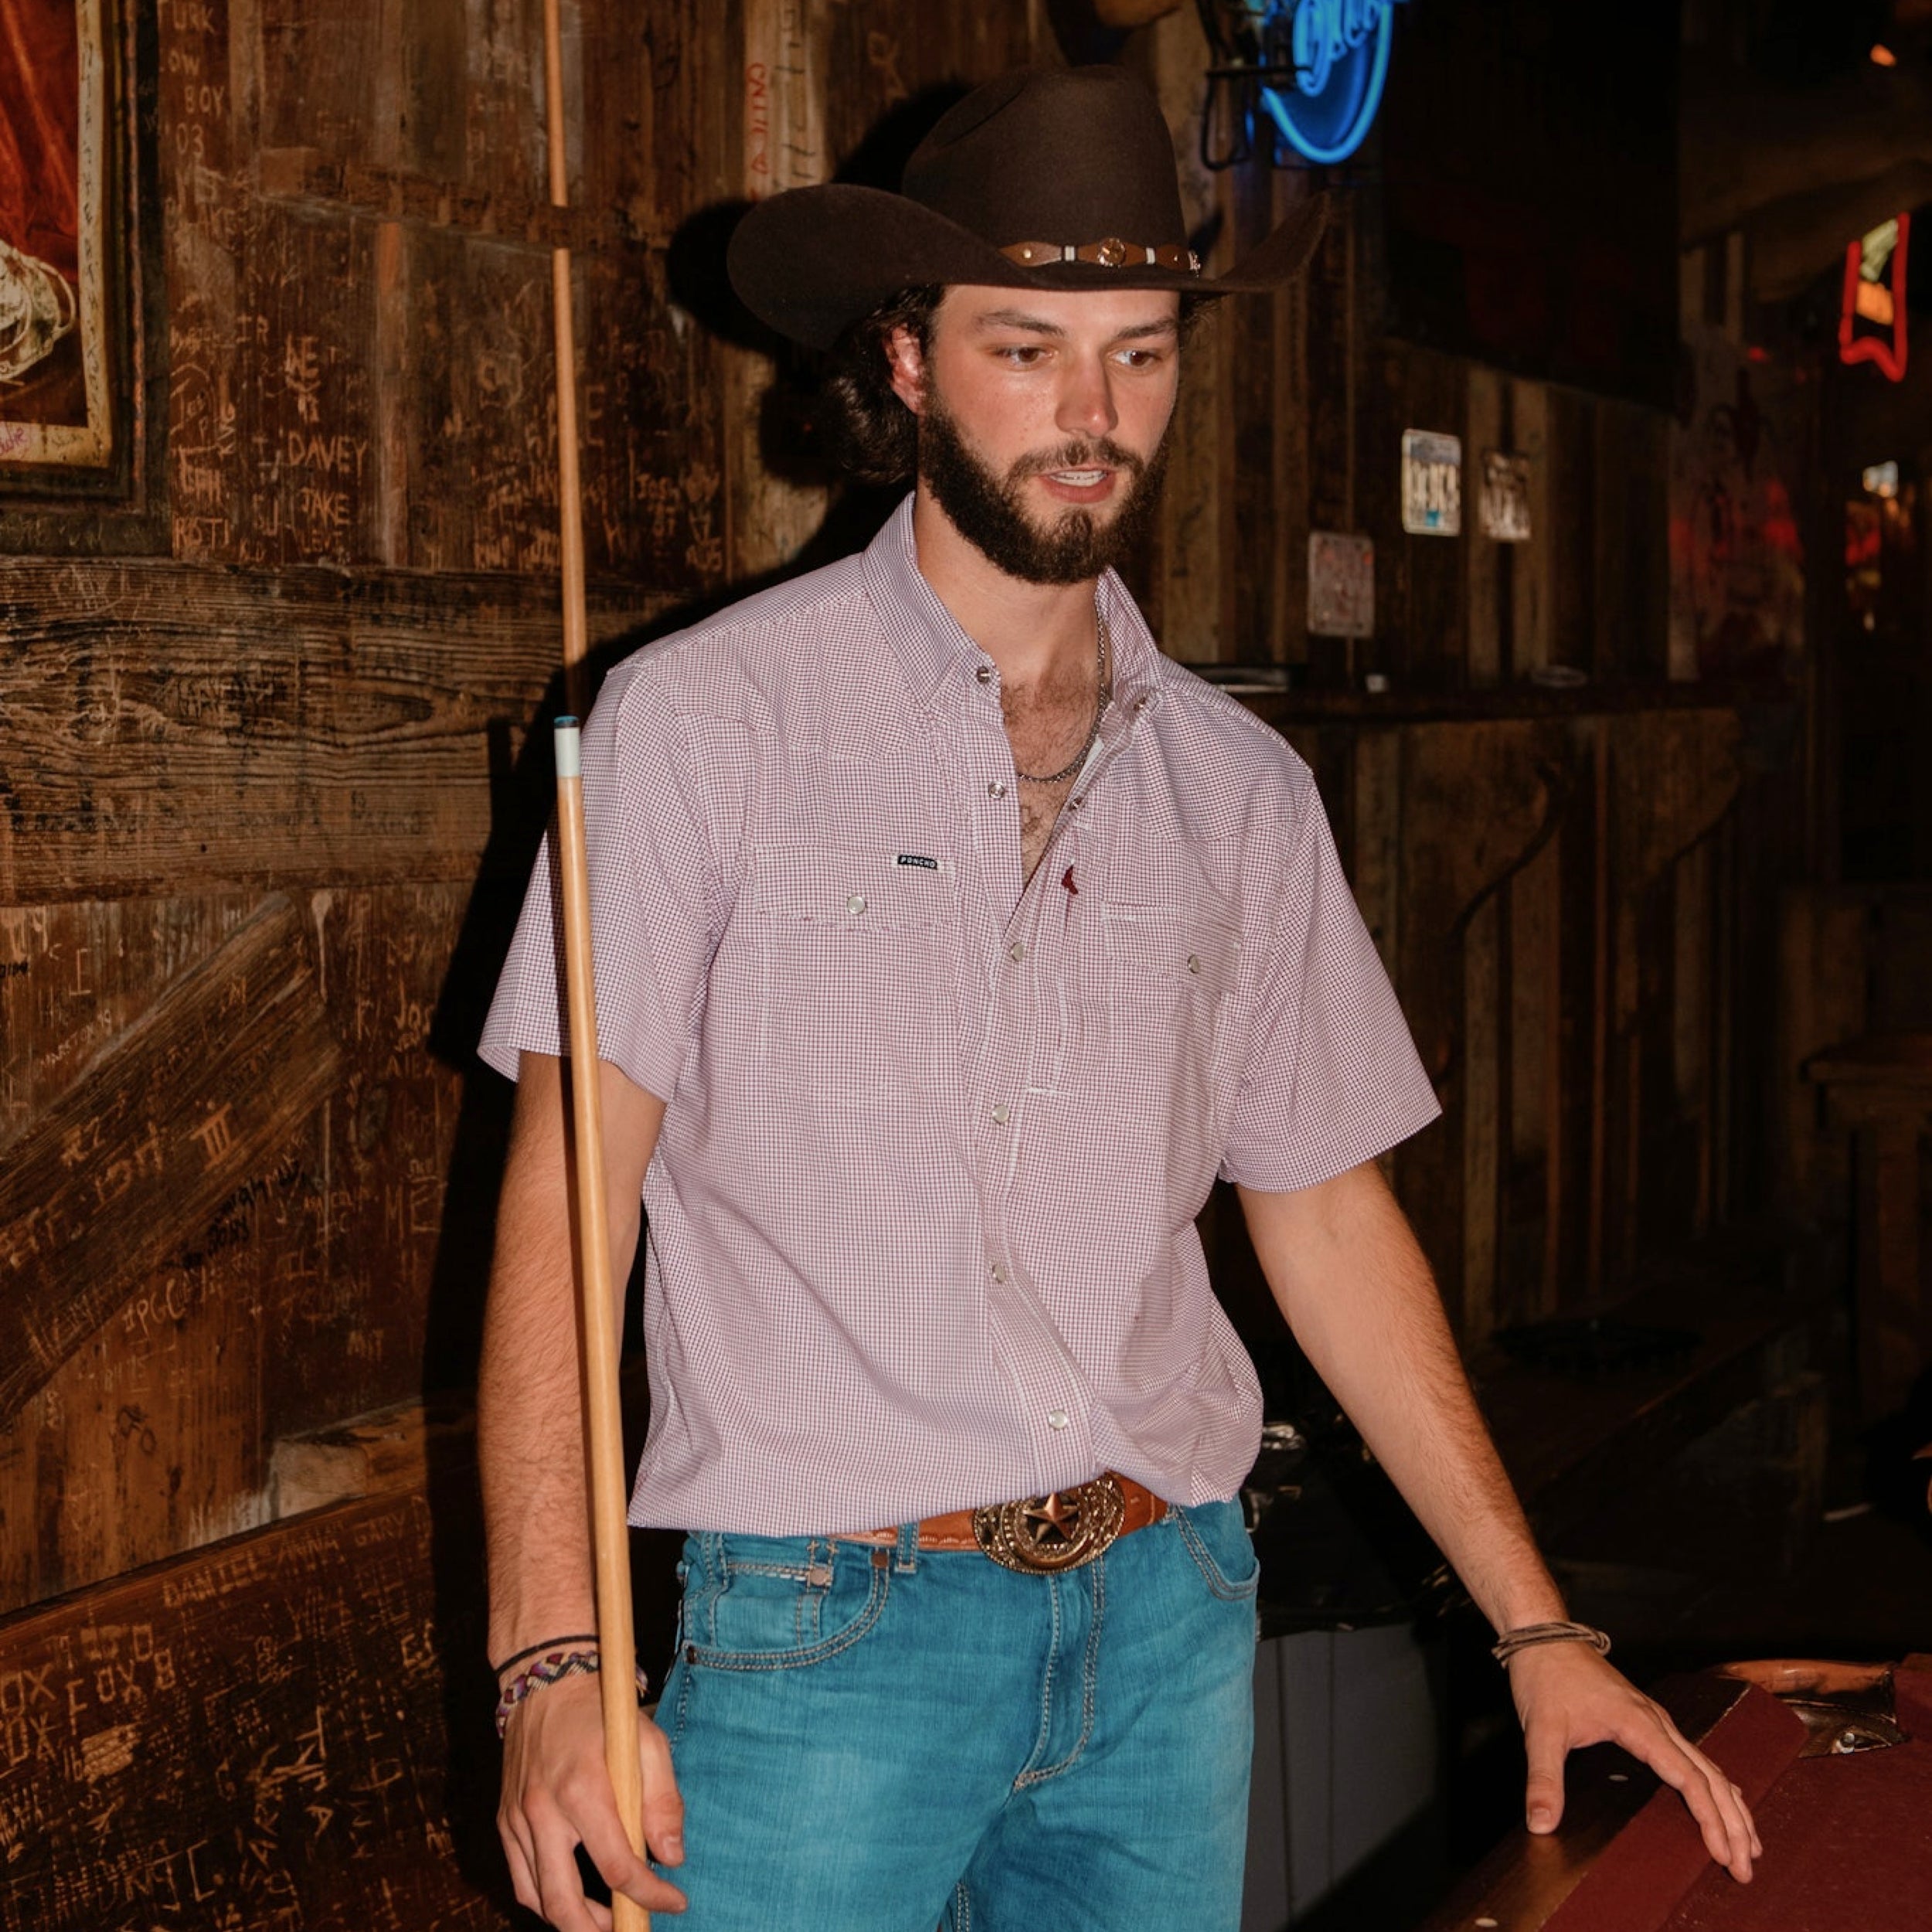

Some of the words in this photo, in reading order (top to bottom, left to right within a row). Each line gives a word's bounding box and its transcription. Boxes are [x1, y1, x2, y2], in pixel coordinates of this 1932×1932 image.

[184, 85, 224, 121] BOY
[287, 430, 369, 487] DAVEY
[299, 487, 351, 526] JAKE
[899, 855, 937, 869] PONCHO
